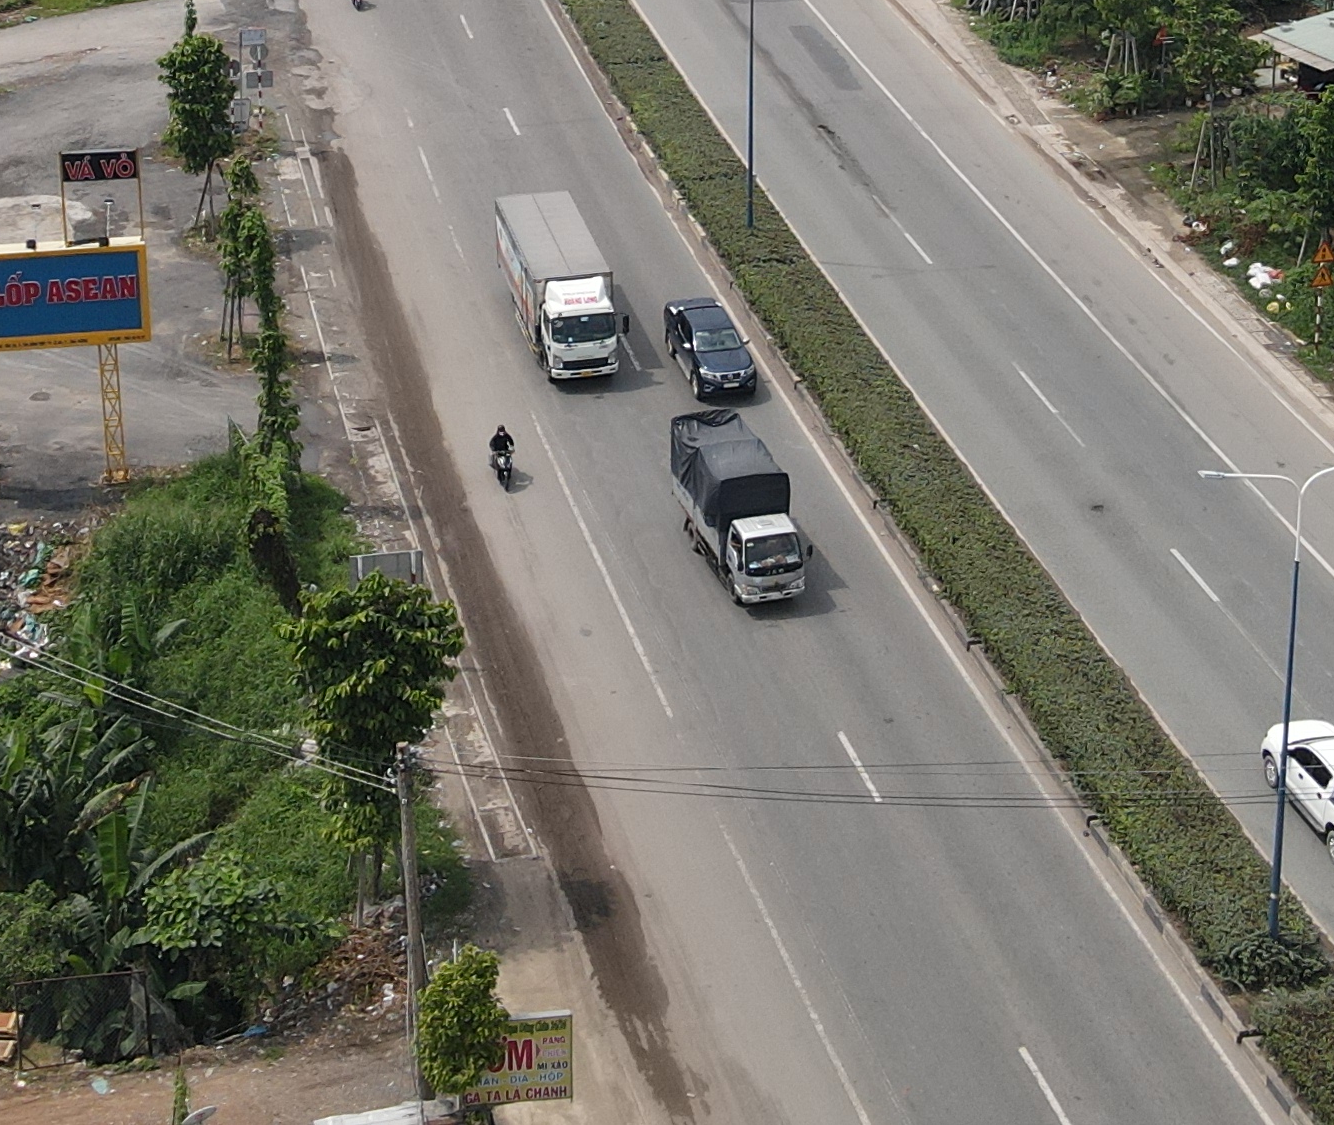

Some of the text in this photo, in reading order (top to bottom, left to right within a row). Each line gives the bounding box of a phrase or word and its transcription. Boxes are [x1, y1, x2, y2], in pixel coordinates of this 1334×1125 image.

[65, 153, 134, 180] VÁ VỎ
[46, 274, 137, 305] ASEAN
[486, 1090, 501, 1102] TA
[525, 1086, 567, 1099] CHANH
